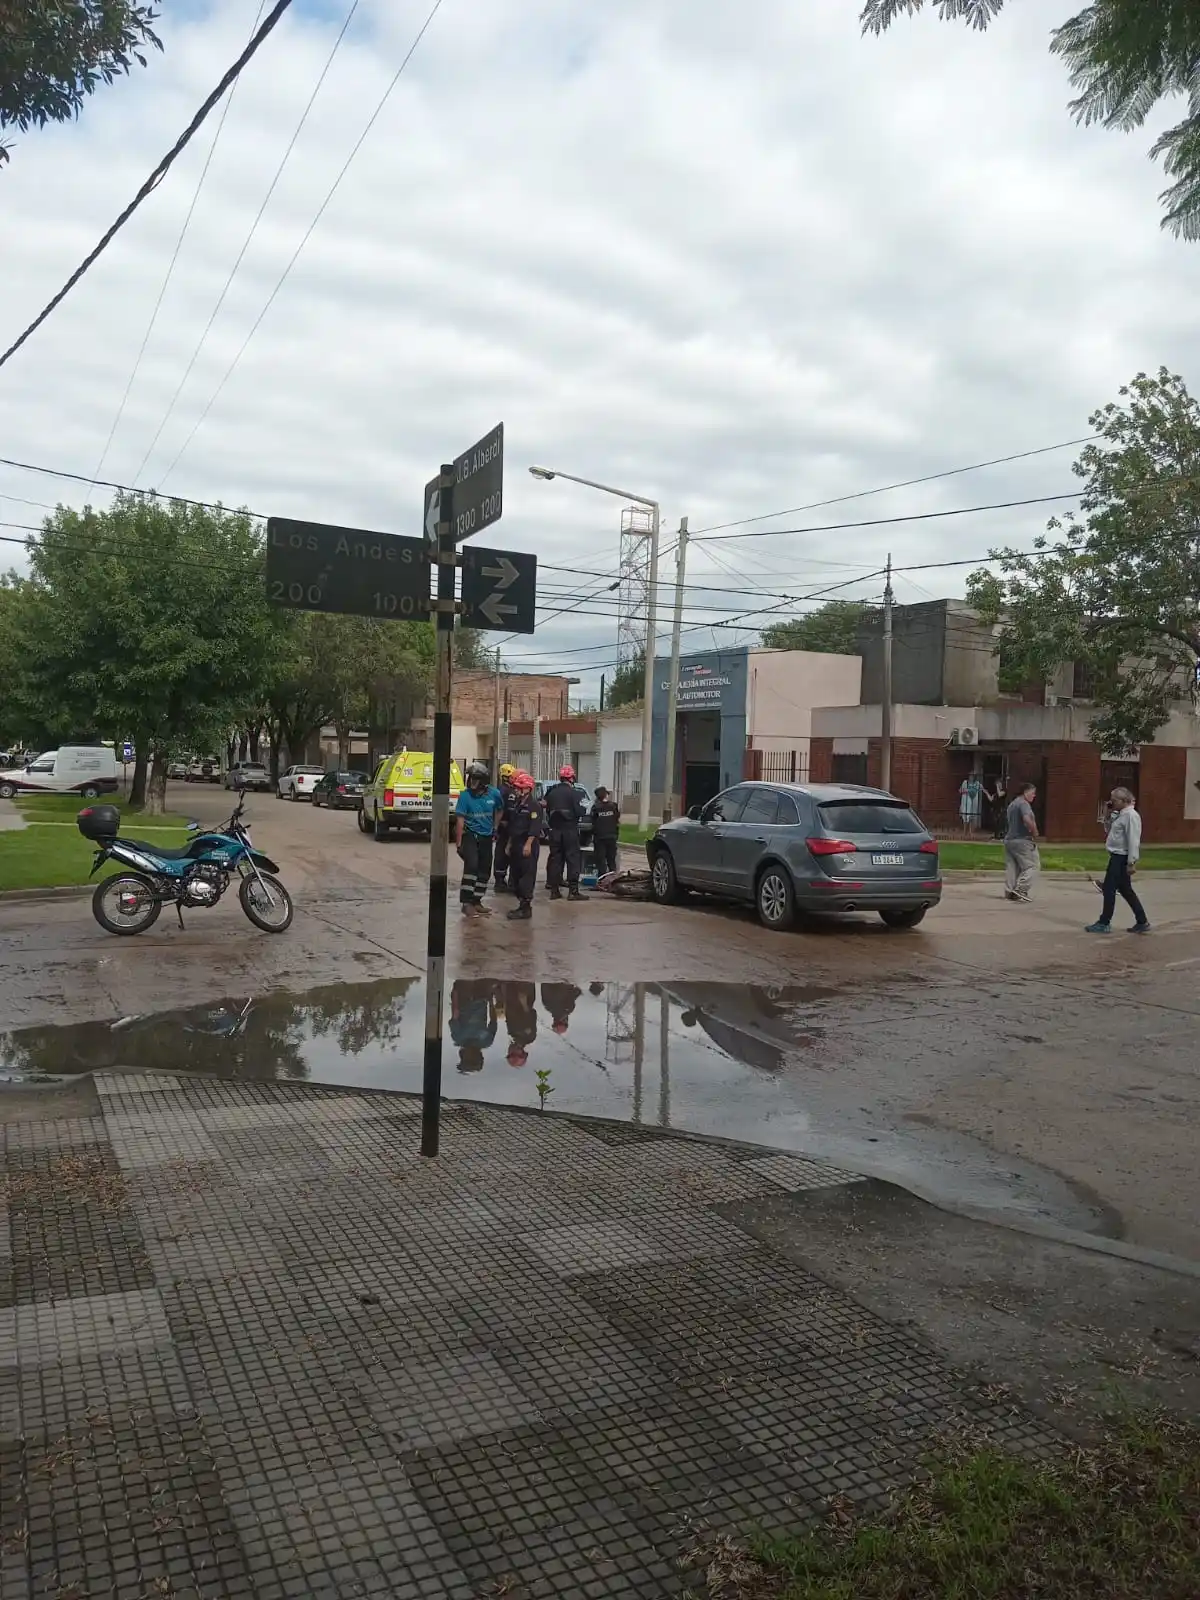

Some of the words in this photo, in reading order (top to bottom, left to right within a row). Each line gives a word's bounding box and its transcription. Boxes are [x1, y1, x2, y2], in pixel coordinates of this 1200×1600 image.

[456, 507, 476, 536] 1300
[480, 491, 501, 521] 1200
[271, 526, 319, 551] Los
[335, 534, 413, 564] Andes
[270, 580, 322, 604] 200
[373, 592, 414, 615] 100
[661, 678, 699, 690] CEAJERÍA
[682, 690, 721, 700] AUTOMOTOR
